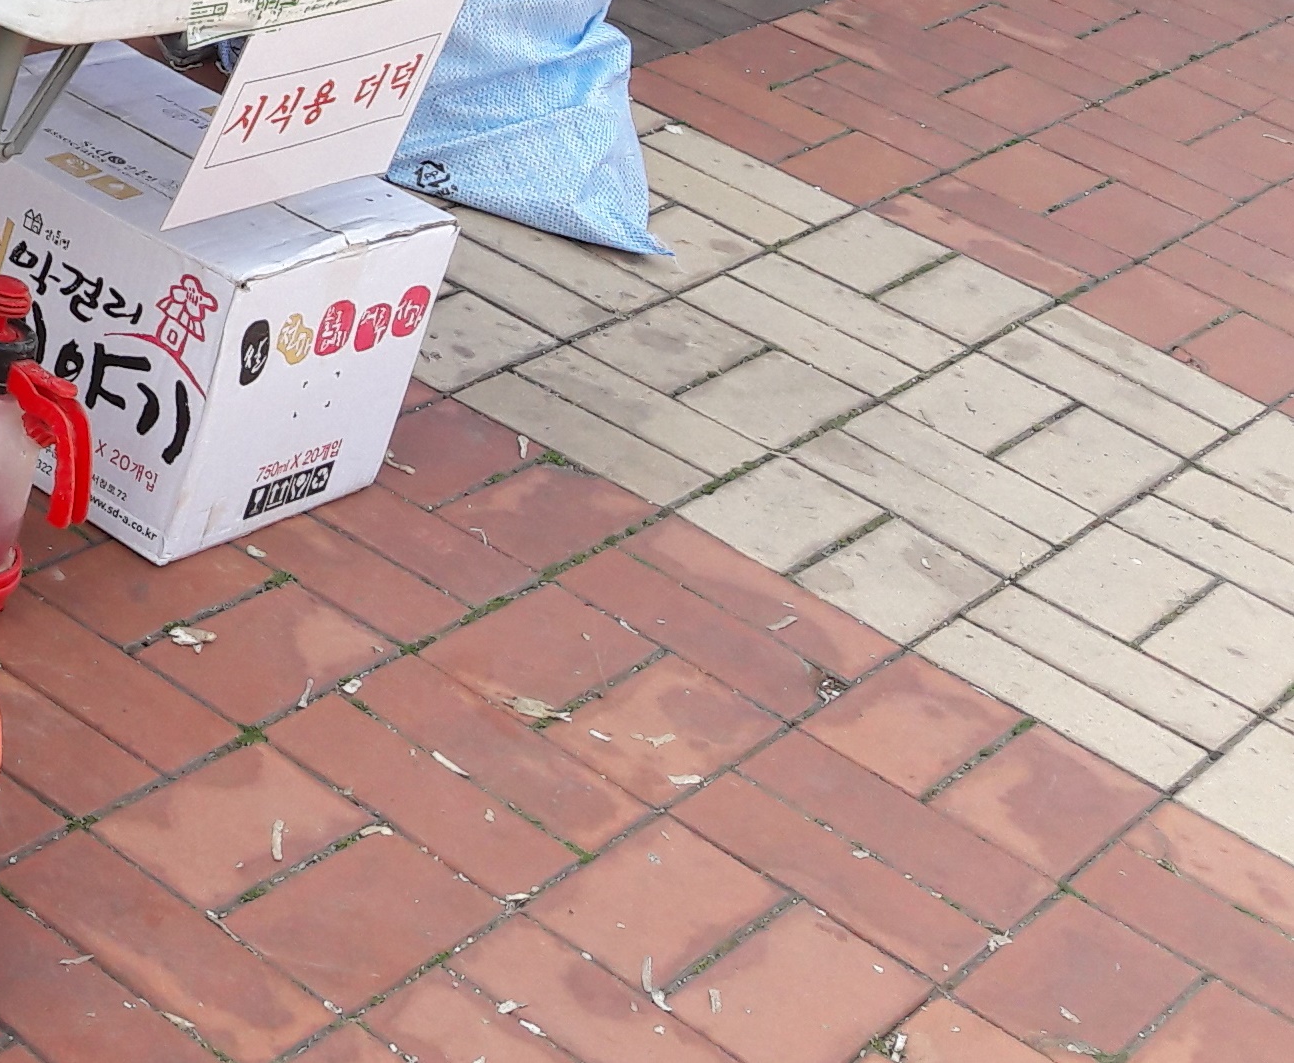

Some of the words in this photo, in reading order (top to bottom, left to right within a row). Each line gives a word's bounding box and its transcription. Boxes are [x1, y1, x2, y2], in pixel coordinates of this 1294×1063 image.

[223, 78, 336, 143] 시식용
[354, 53, 424, 109] 더덕
[9, 240, 143, 325] 막걸리
[109, 449, 159, 493] 20개입
[256, 460, 290, 483] 750ml
[302, 438, 343, 467] 20개입
